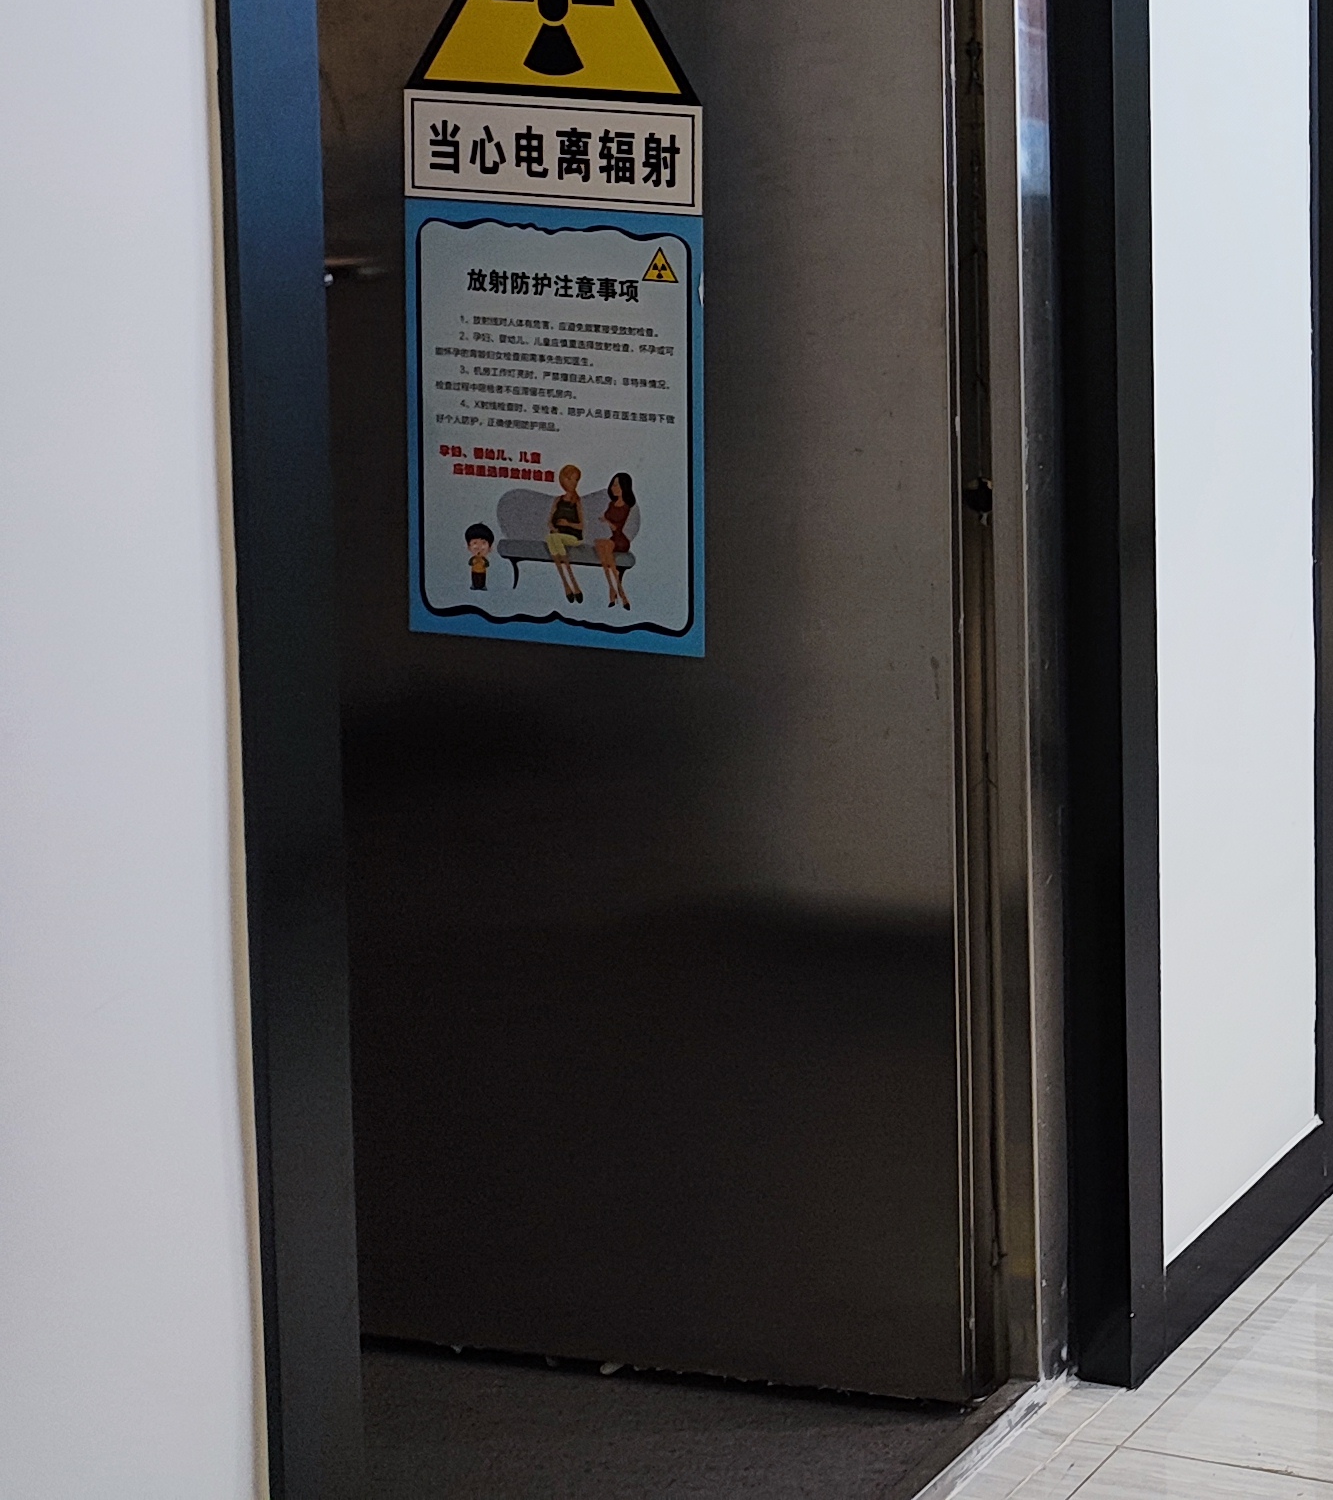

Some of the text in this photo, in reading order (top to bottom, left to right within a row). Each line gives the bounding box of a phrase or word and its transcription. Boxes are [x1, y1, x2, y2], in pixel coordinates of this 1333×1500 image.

[428, 119, 682, 189] 当心电离辐射
[467, 268, 640, 303] 放射防护注意事项
